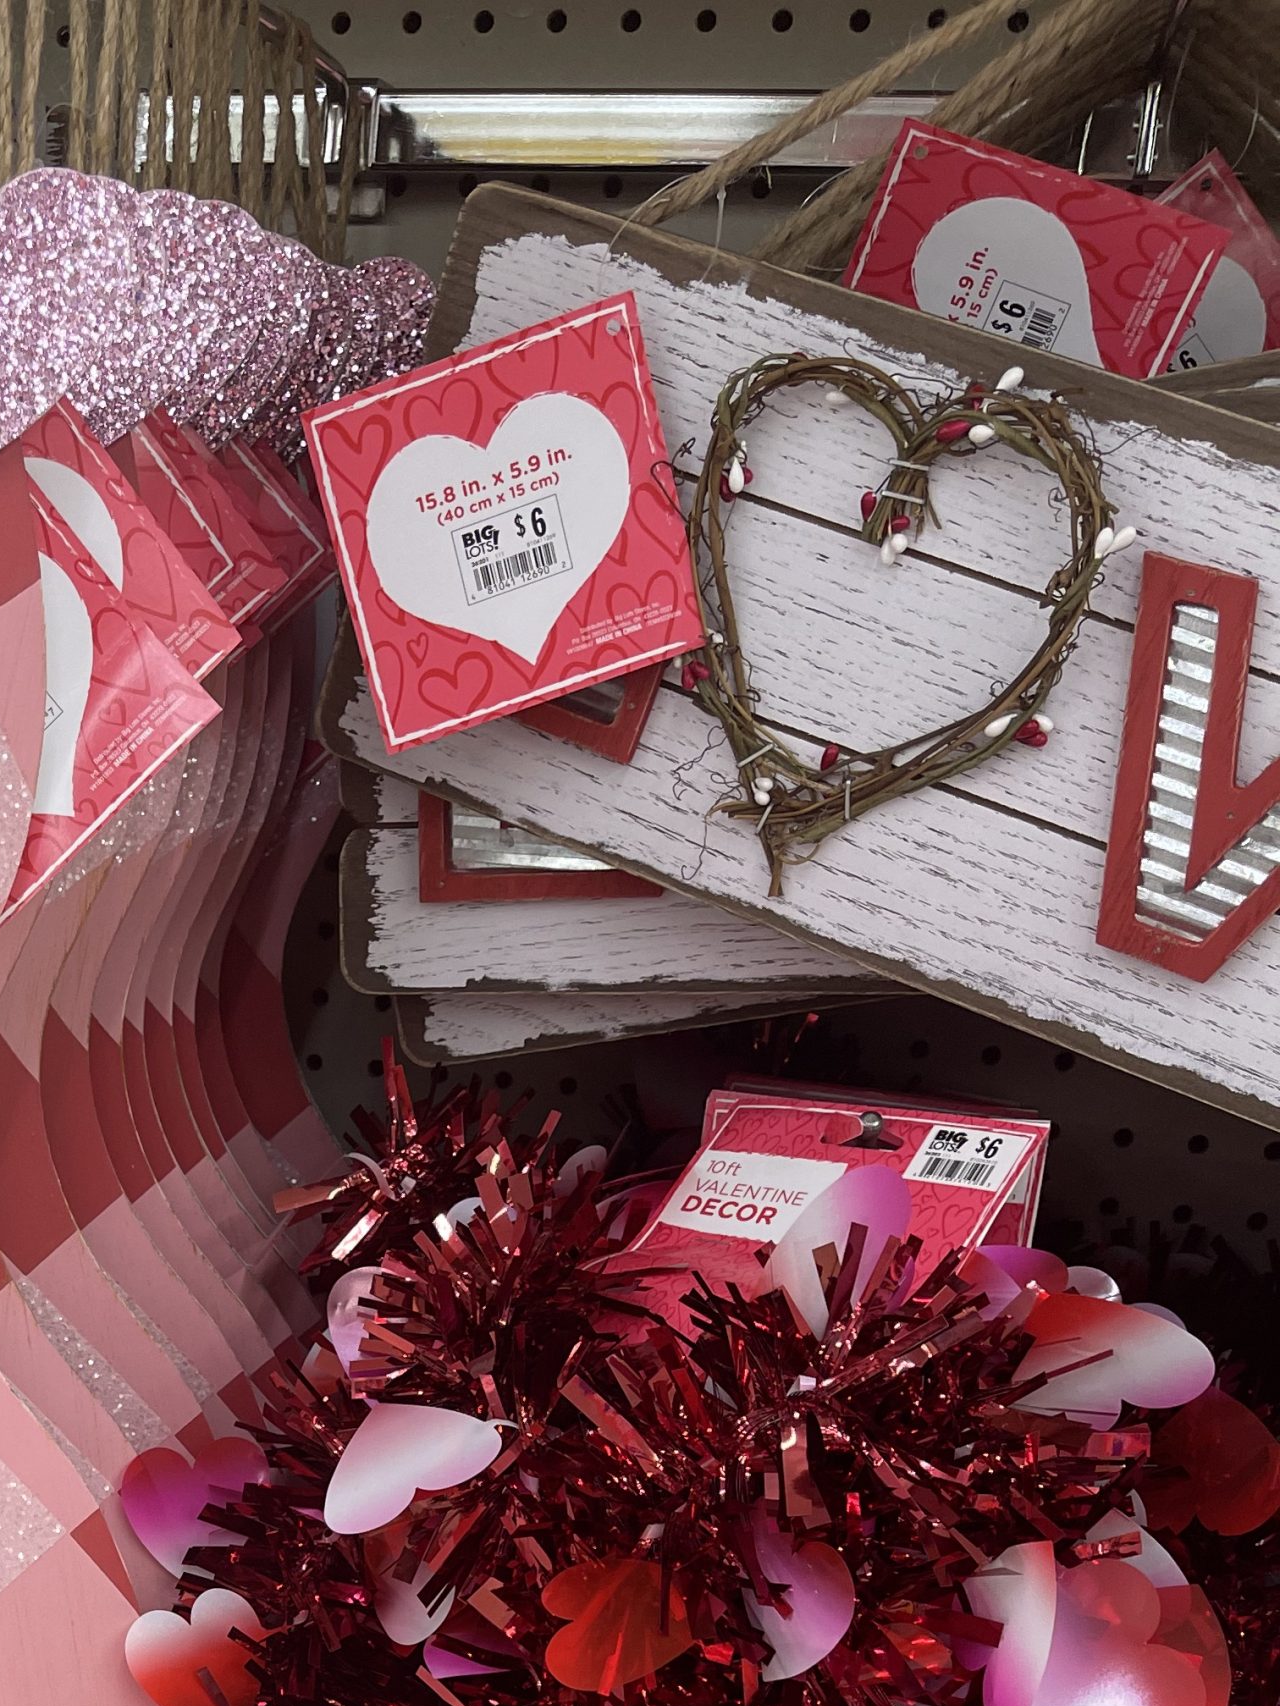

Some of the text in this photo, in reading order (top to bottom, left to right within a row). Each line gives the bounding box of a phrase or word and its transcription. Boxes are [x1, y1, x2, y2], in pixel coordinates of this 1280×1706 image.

[950, 247, 989, 309] 5.9 in.
[967, 302, 982, 319] 15
[415, 448, 573, 513] 15.8 in. x 5.9 in.
[437, 471, 560, 527] (40 cm x 15 cm)
[461, 524, 495, 548] BIG
[487, 565, 550, 595] 81041 12690
[934, 1129, 969, 1142] BIG
[695, 1177, 808, 1207] VALENTINE
[680, 1195, 778, 1225] DECOR
